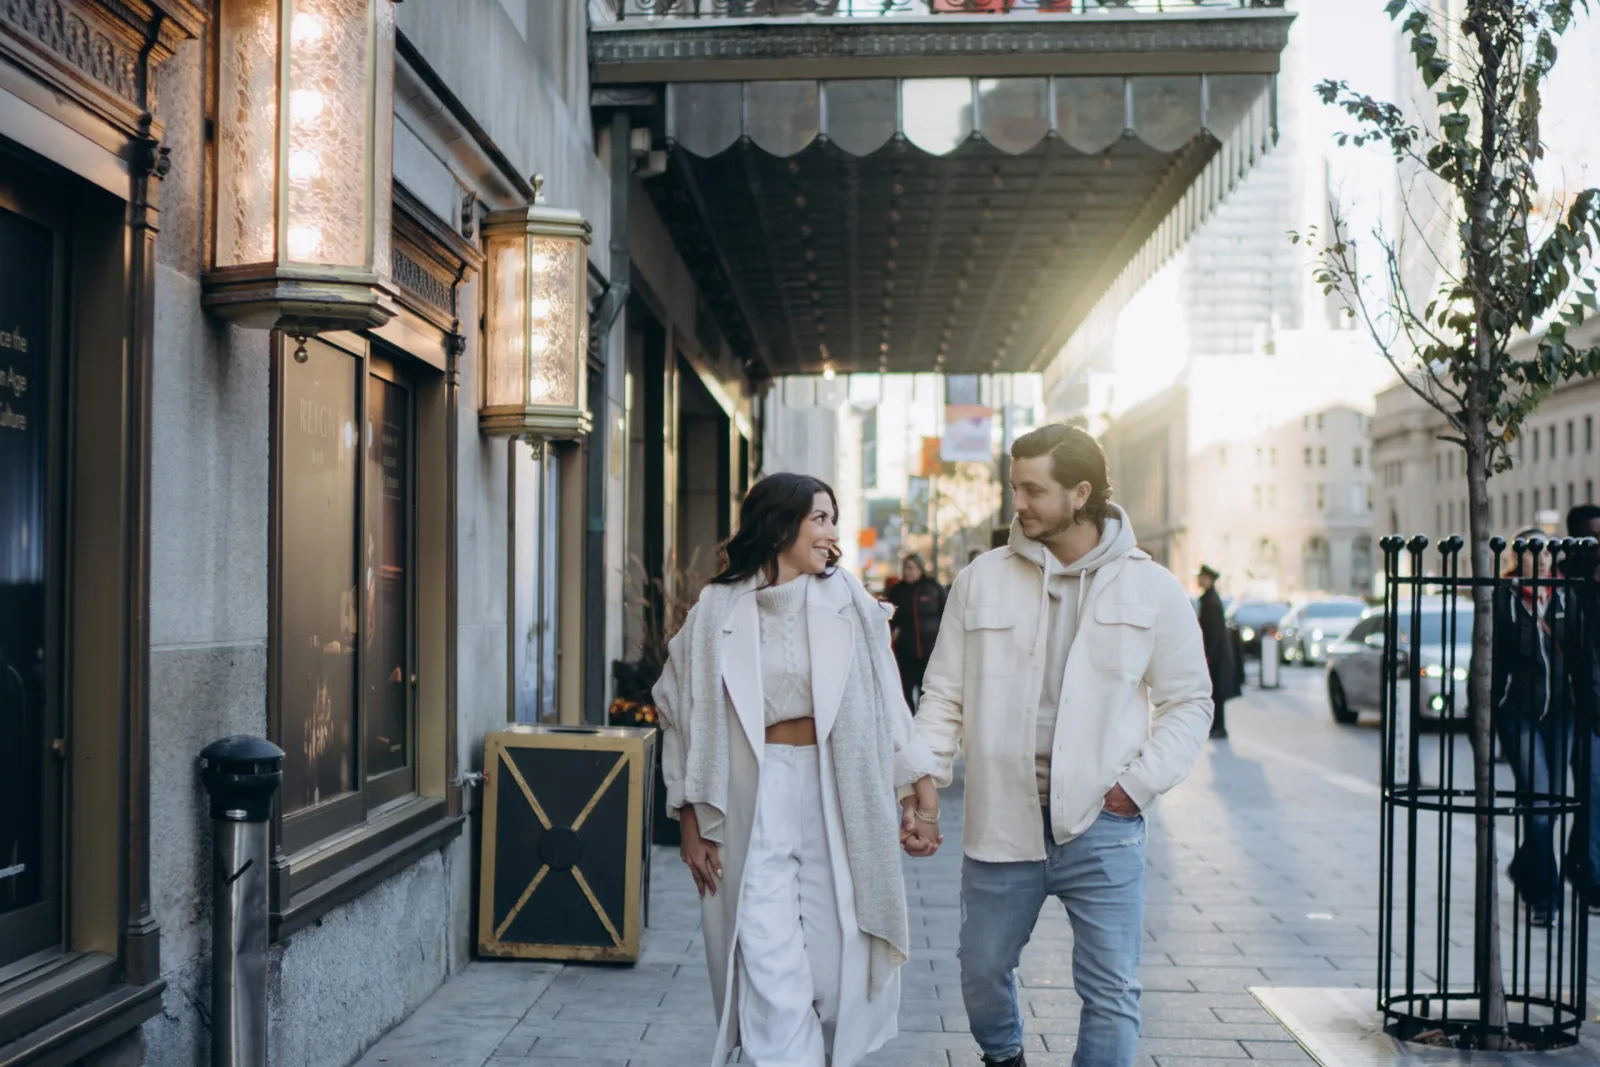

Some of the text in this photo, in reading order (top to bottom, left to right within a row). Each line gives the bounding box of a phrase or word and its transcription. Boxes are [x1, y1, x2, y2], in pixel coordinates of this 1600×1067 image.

[7, 365, 28, 398] Age
[0, 401, 28, 431] ulture
[300, 398, 336, 440] REIGN
